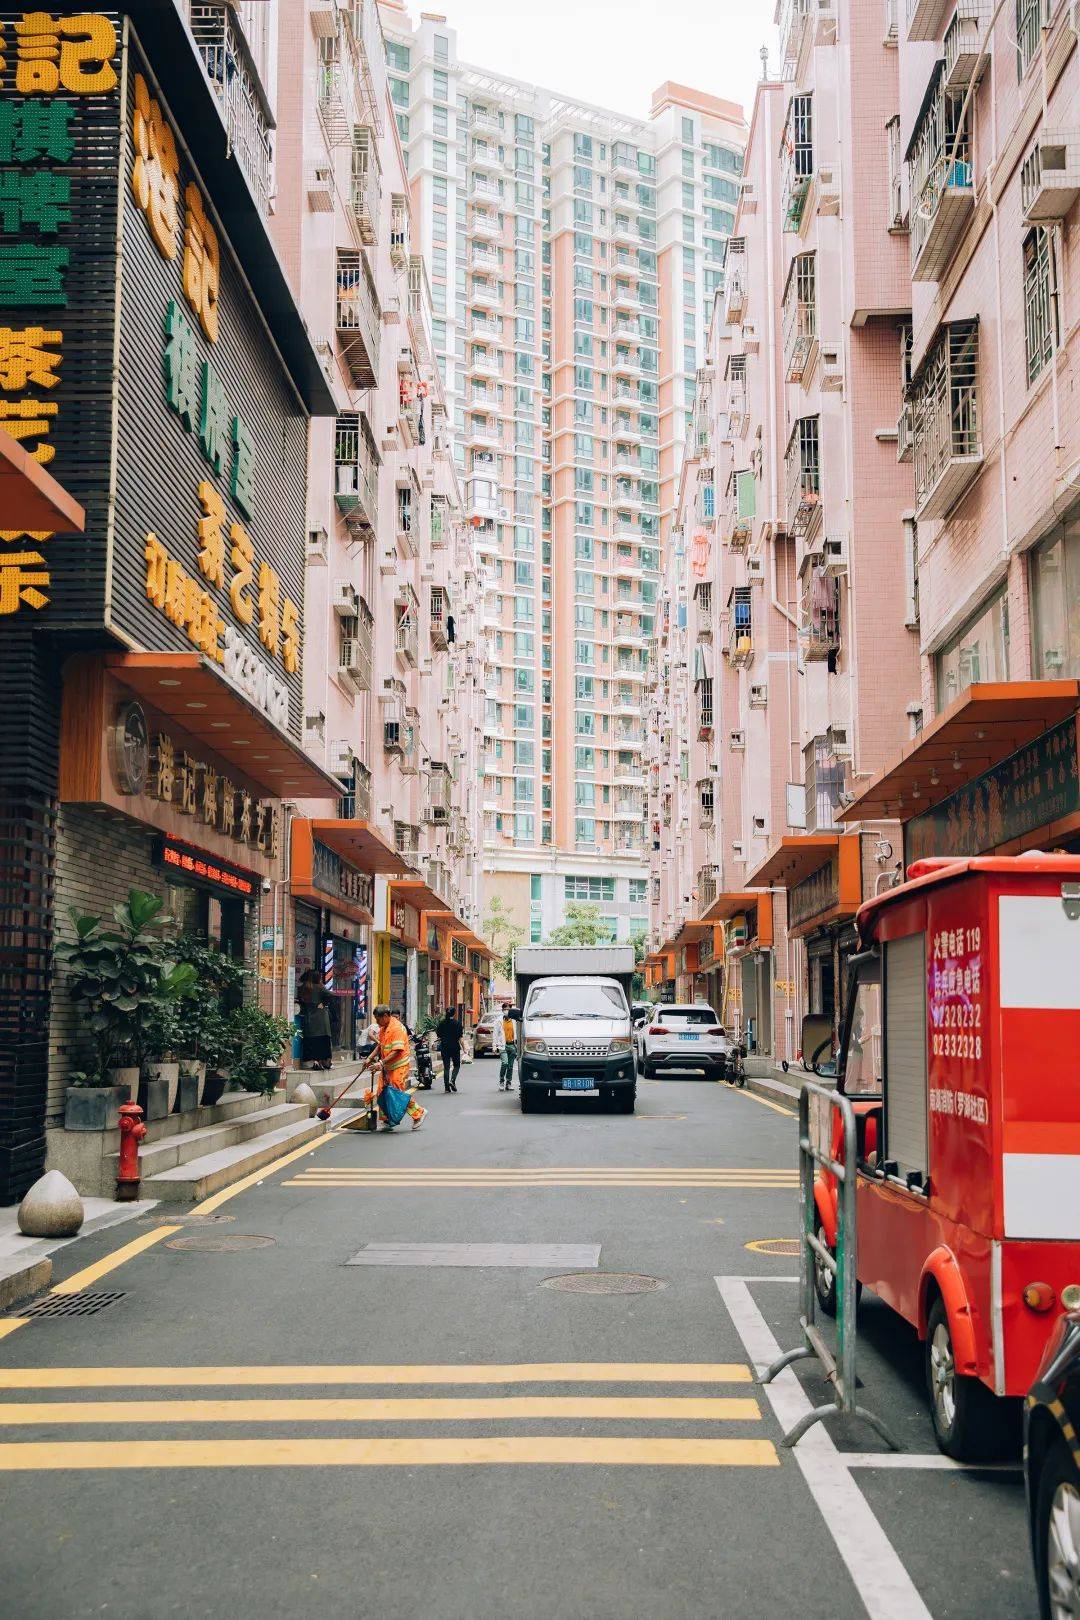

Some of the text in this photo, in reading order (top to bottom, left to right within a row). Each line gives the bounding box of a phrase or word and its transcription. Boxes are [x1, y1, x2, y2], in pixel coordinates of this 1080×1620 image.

[0, 12, 118, 93] 記
[0, 327, 63, 615] 茶艺乐
[933, 927, 981, 960] 火警电话 119
[933, 1034, 982, 1059] 82332328
